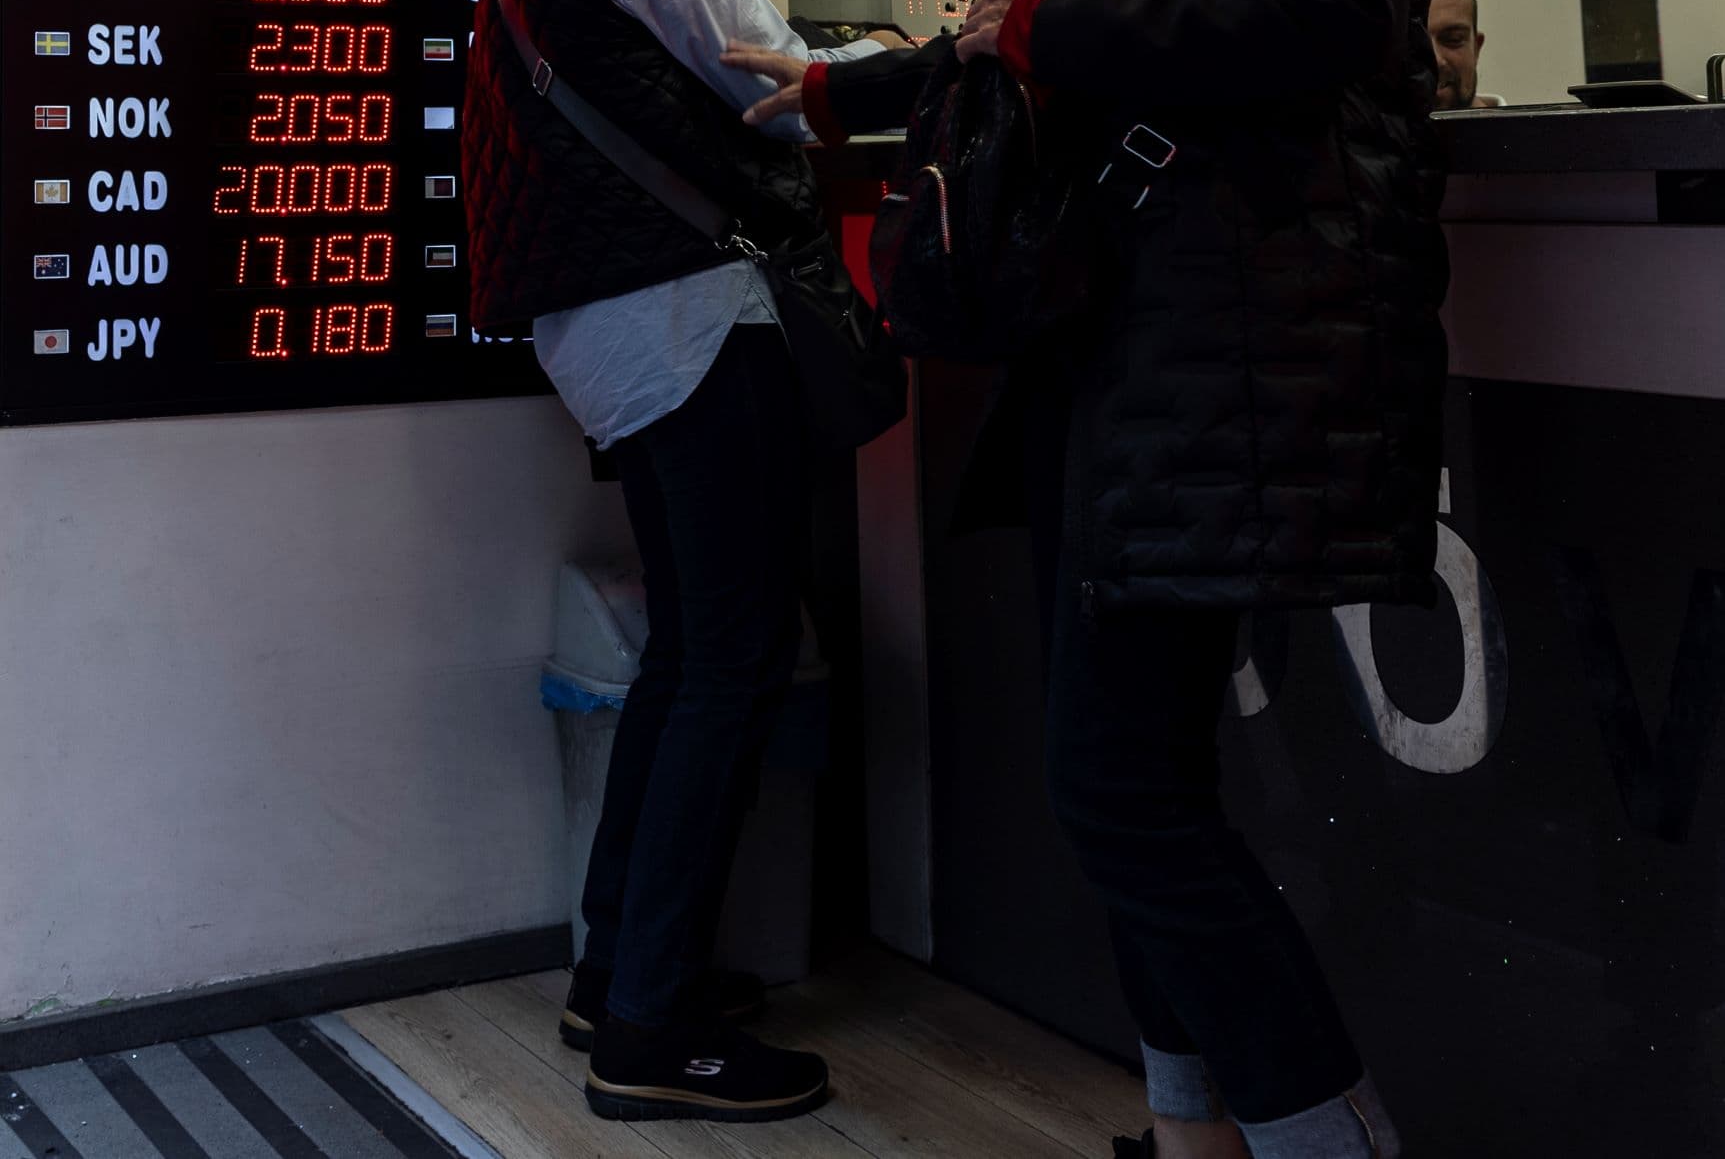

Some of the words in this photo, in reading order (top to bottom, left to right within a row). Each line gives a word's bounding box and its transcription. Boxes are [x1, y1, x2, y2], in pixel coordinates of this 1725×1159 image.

[87, 23, 163, 66] SEK
[250, 24, 390, 72] 2.300
[89, 97, 172, 139] NOK
[250, 94, 391, 142] 2.050
[87, 170, 168, 213] CAD
[214, 164, 391, 215] 20.000
[87, 244, 168, 287] AUD
[238, 234, 392, 286] 17.150
[87, 317, 161, 361] JPY
[251, 304, 393, 357] 0.180
